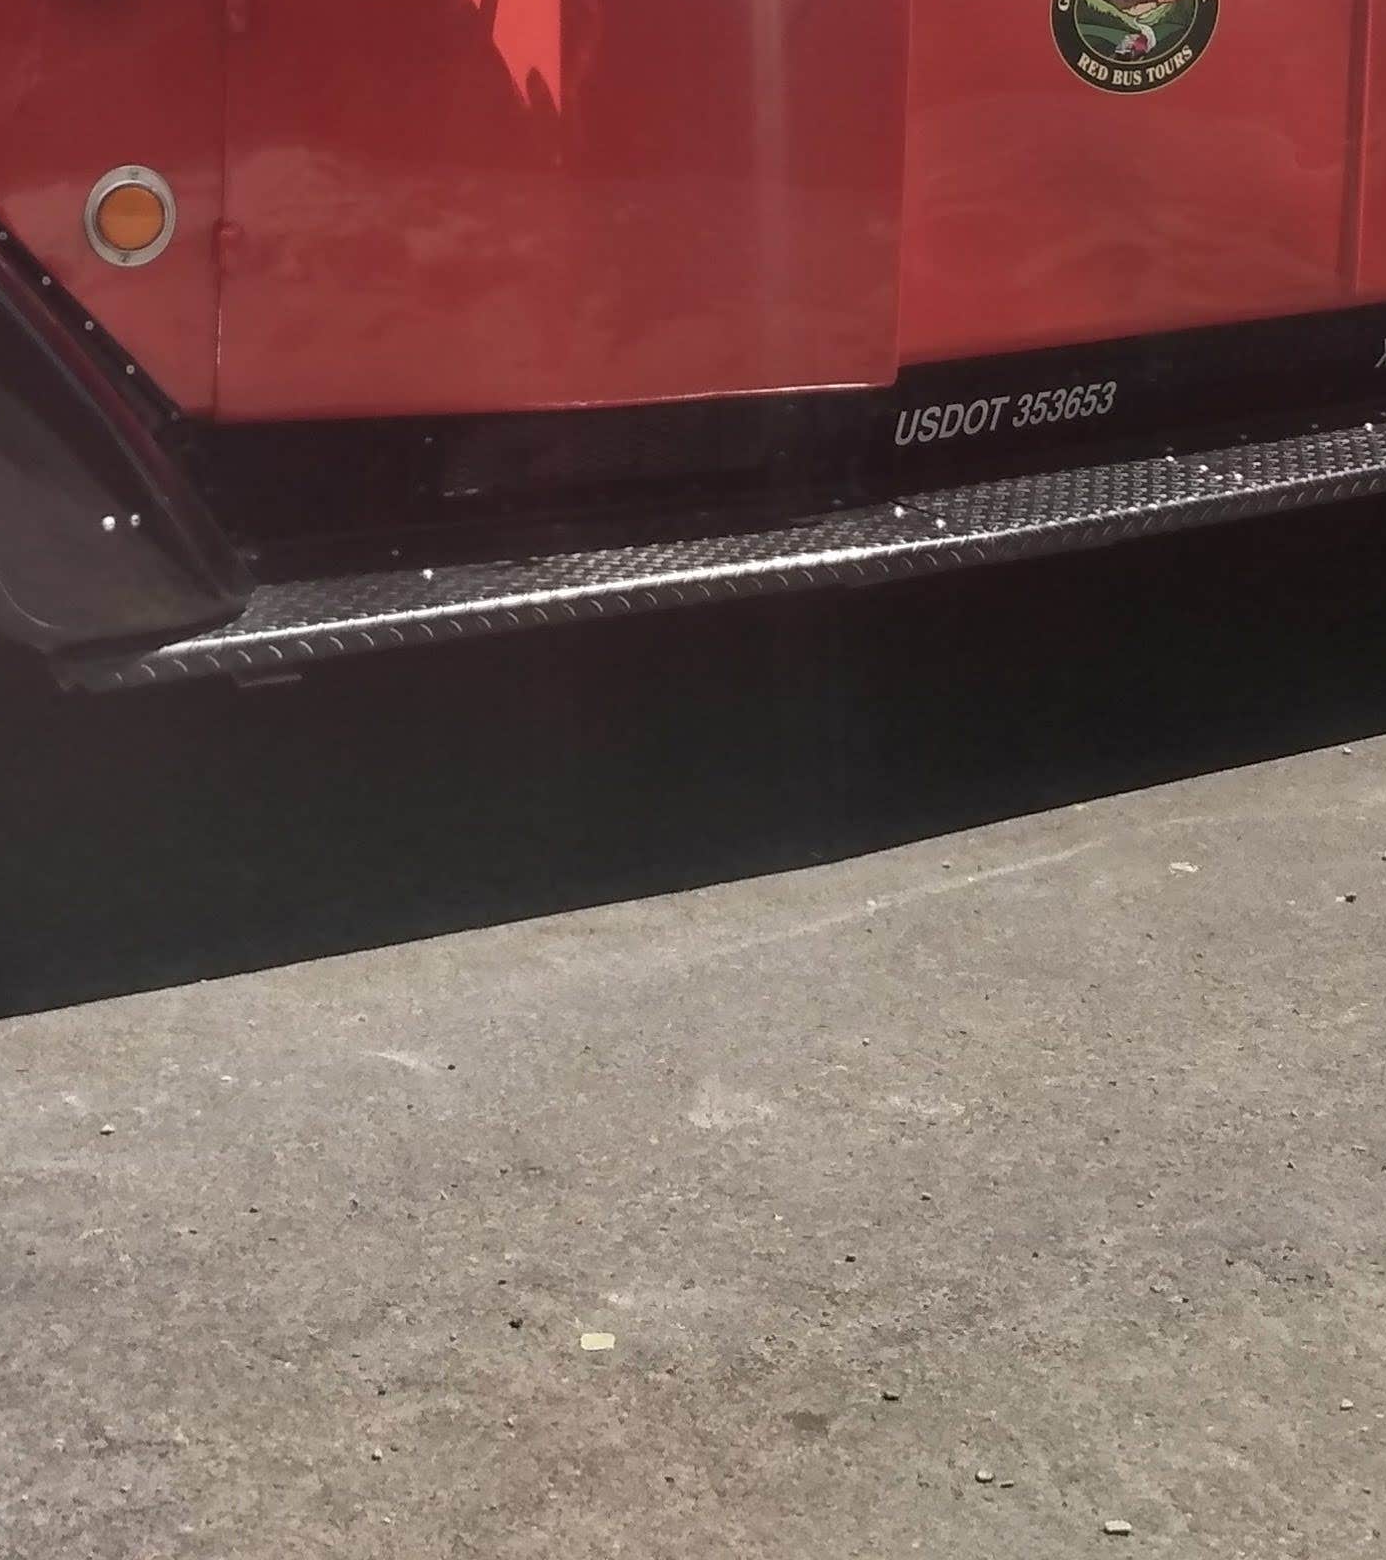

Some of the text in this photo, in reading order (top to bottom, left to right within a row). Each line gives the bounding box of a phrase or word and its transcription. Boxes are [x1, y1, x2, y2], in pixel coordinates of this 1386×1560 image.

[1076, 45, 1194, 86] RED BUS TOURS
[894, 380, 1118, 445] USDOT 353653
